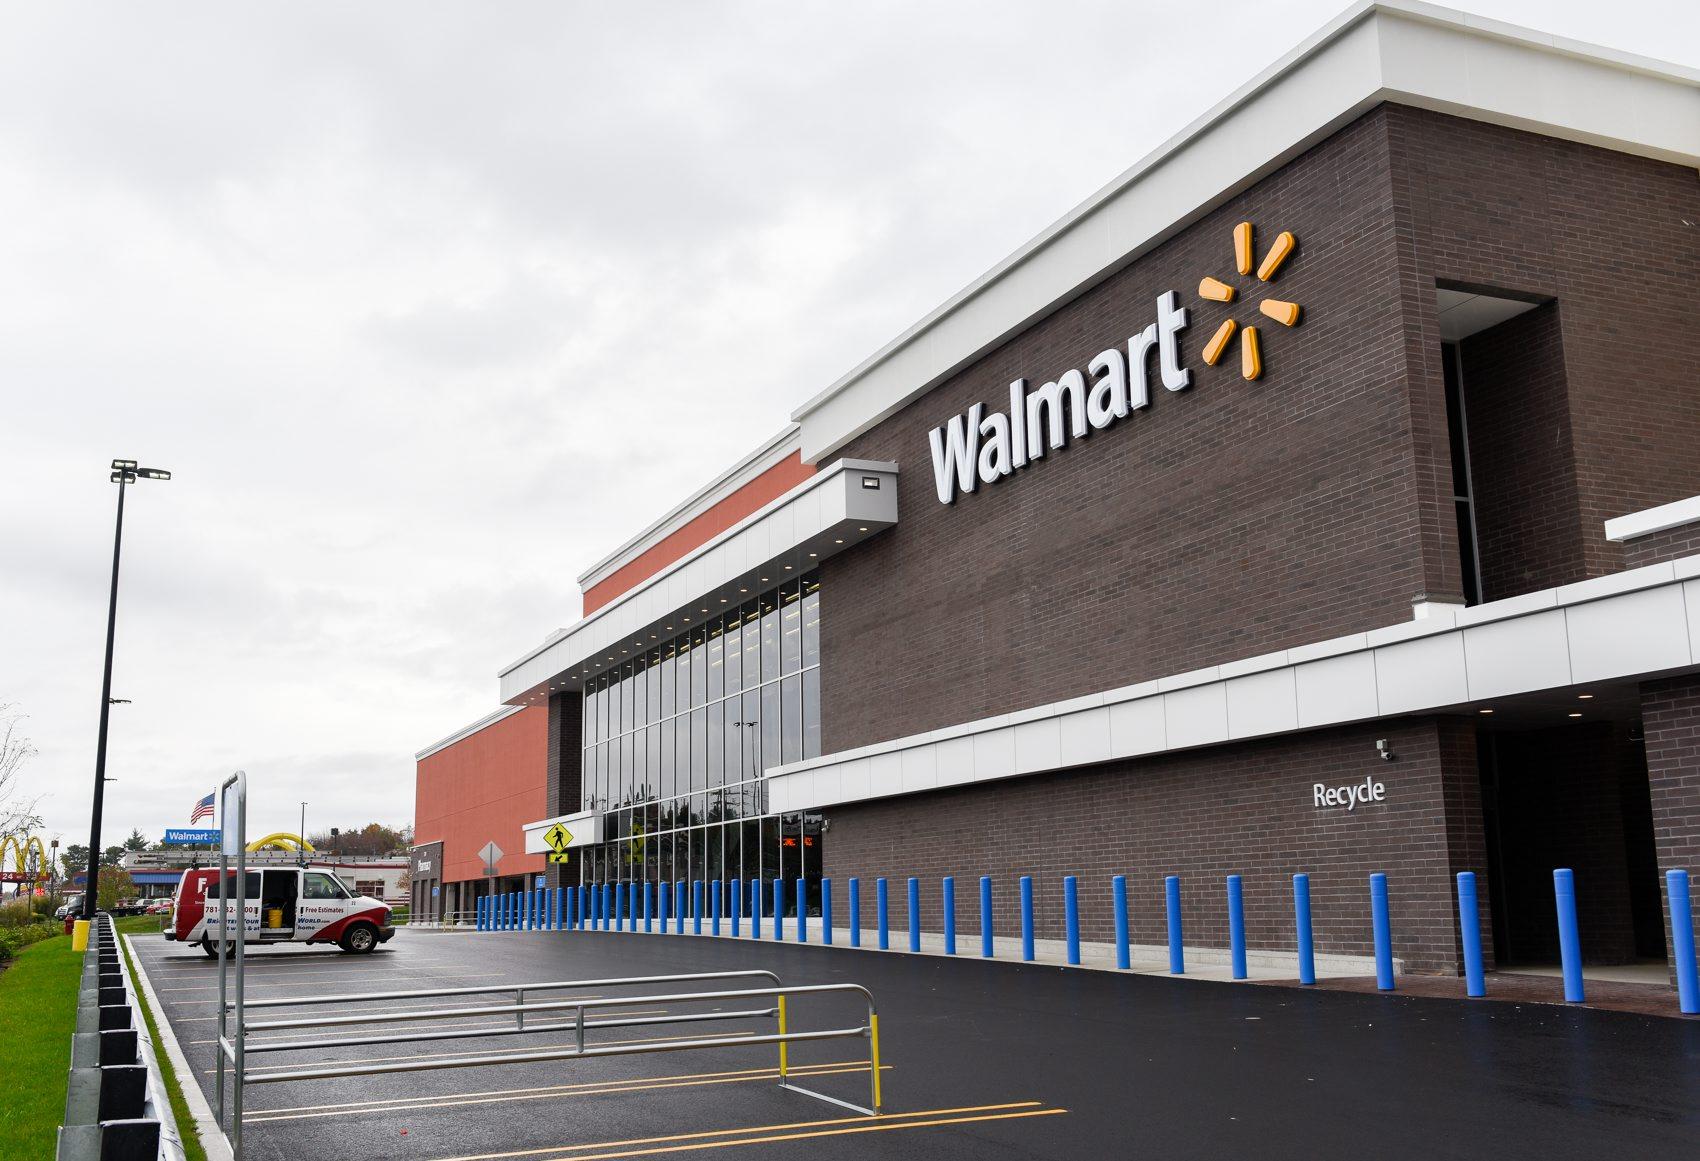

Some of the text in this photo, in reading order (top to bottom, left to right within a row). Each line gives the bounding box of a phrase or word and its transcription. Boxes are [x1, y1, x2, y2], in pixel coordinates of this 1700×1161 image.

[928, 290, 1190, 505] Walmart
[1313, 776, 1386, 811] Recycle
[168, 831, 209, 841] Walmart
